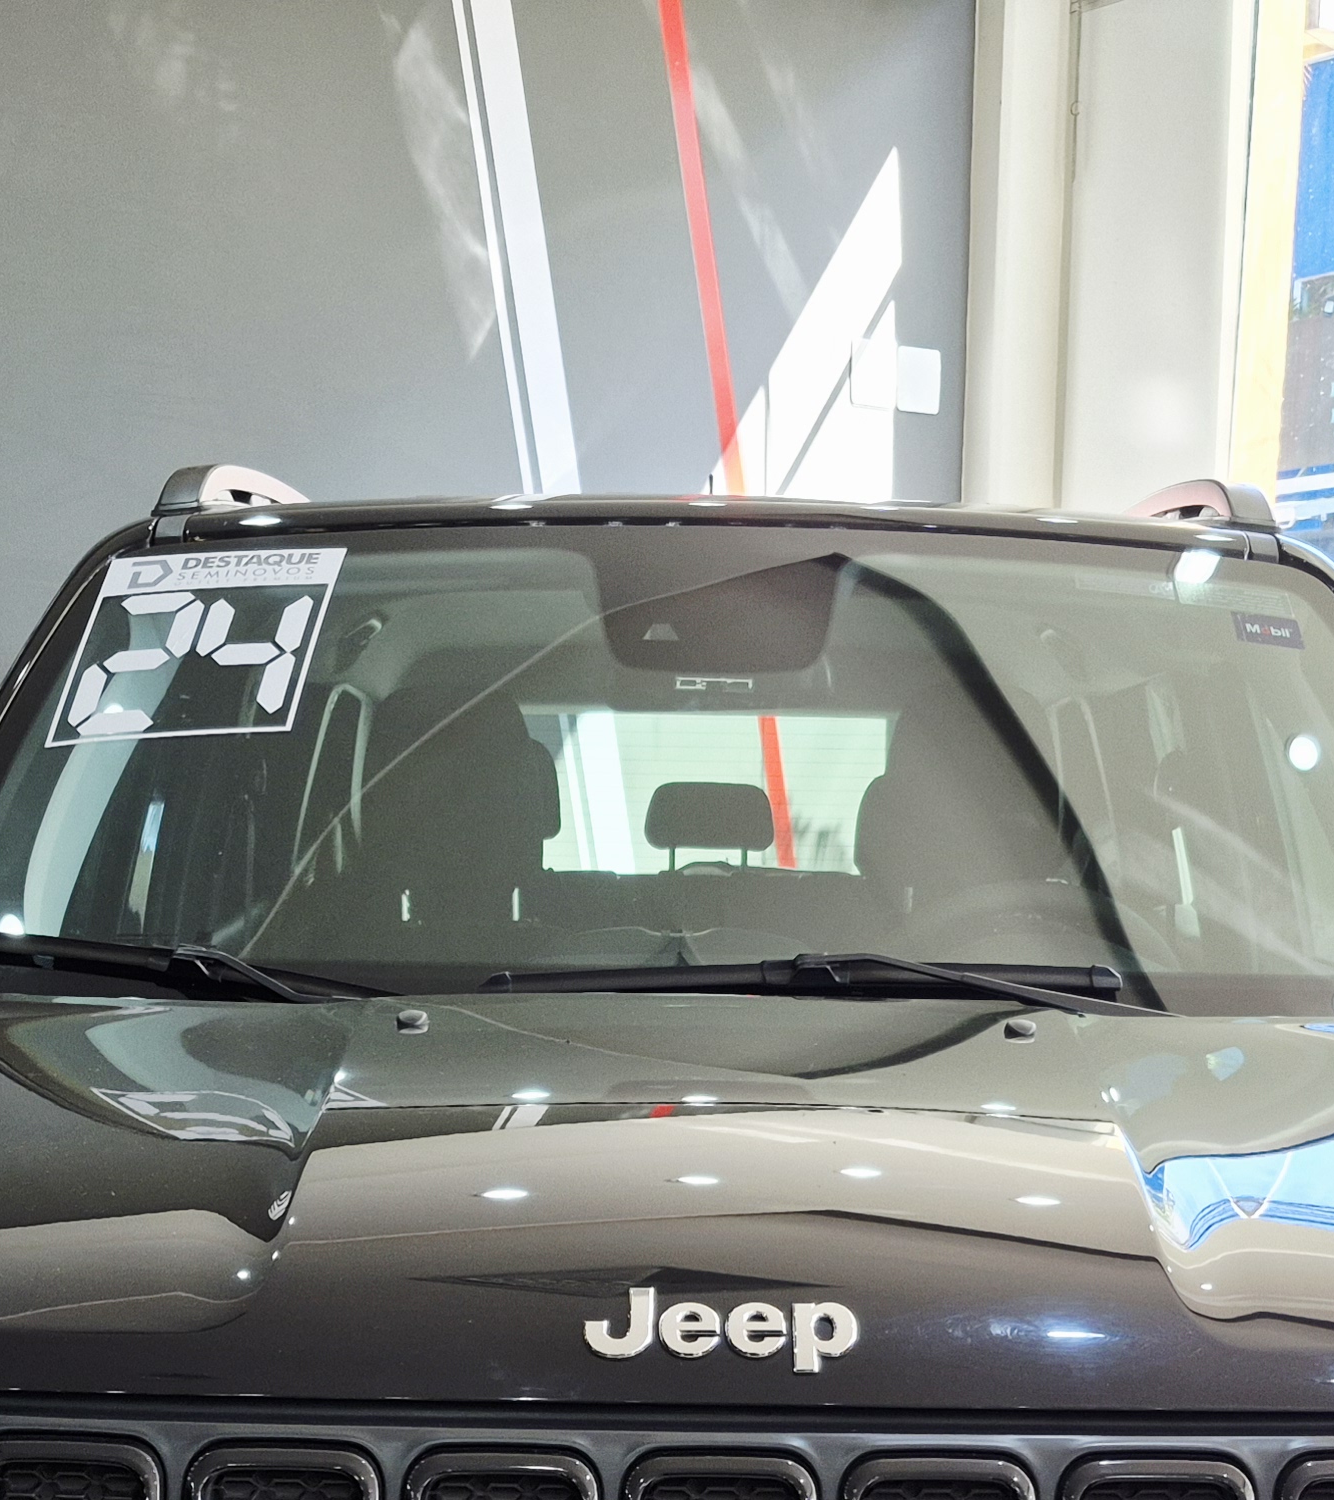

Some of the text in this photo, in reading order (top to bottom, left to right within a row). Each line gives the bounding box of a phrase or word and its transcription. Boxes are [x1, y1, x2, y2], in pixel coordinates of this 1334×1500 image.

[181, 552, 322, 570] DESTAQUE
[177, 566, 315, 581] SEMINOVOS
[1245, 623, 1291, 638] Mobil
[67, 591, 314, 736] 24
[583, 1286, 860, 1374] Jeep
